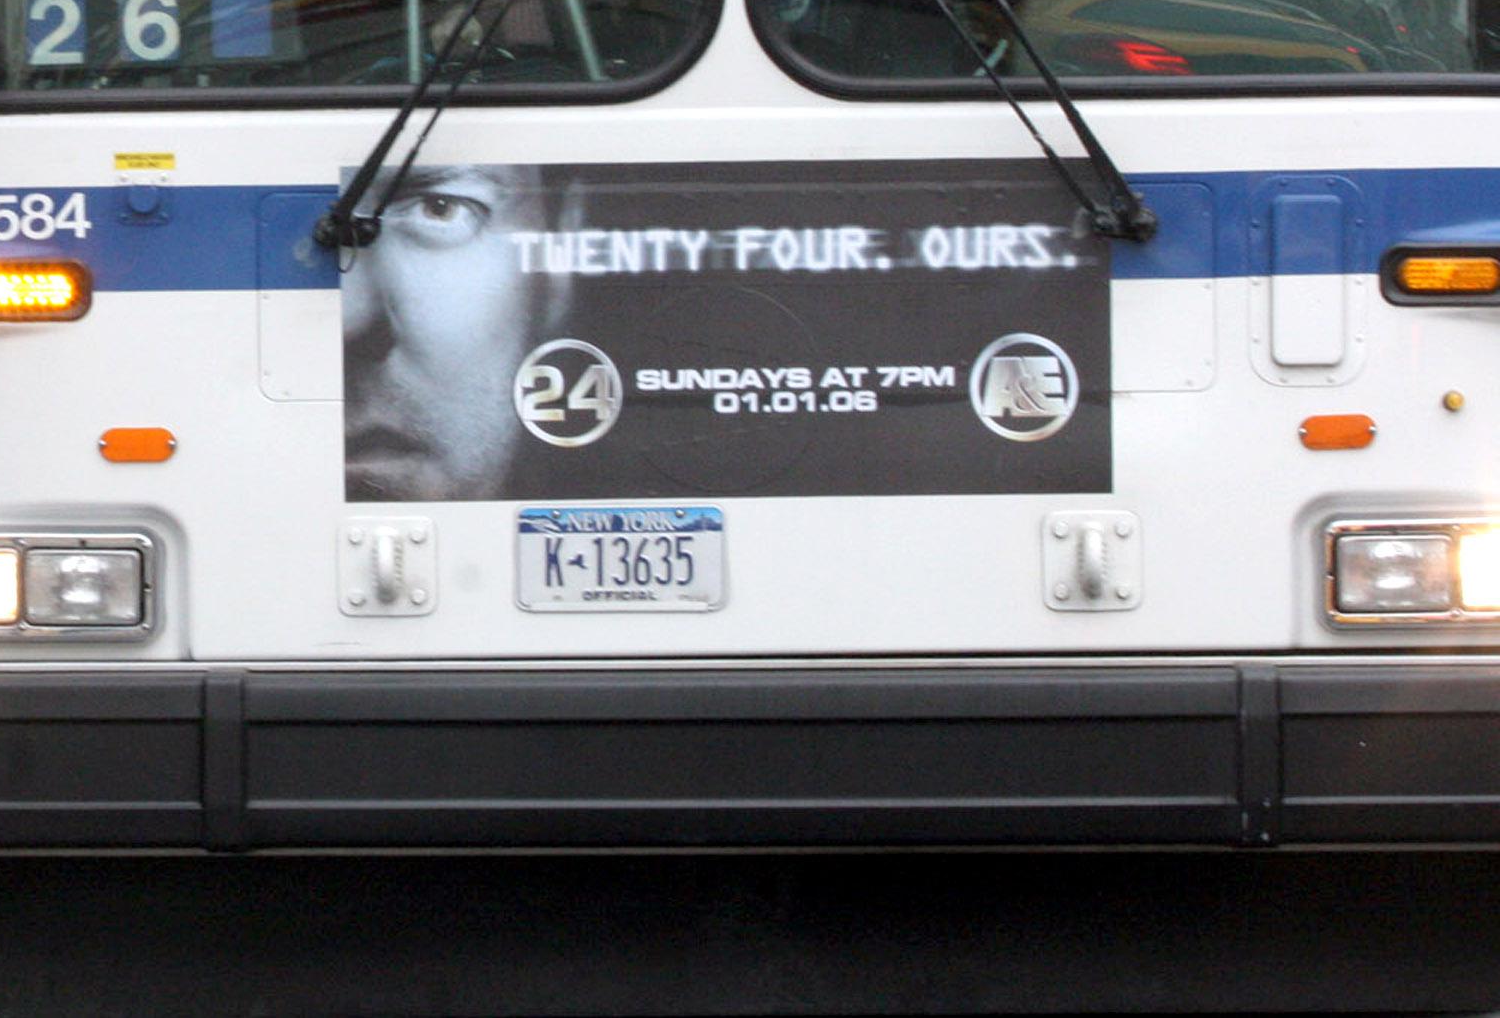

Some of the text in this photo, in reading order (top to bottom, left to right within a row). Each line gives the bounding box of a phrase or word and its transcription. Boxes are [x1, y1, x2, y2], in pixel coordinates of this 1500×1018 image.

[510, 224, 1078, 273] TWENTY FOUR. OURS.
[635, 365, 957, 391] SUNDAYS AT 7PM
[520, 364, 617, 422] 24
[712, 390, 878, 414] 01.01.06
[566, 512, 675, 532] NEW YORK
[581, 590, 659, 602] OFFICIAL
